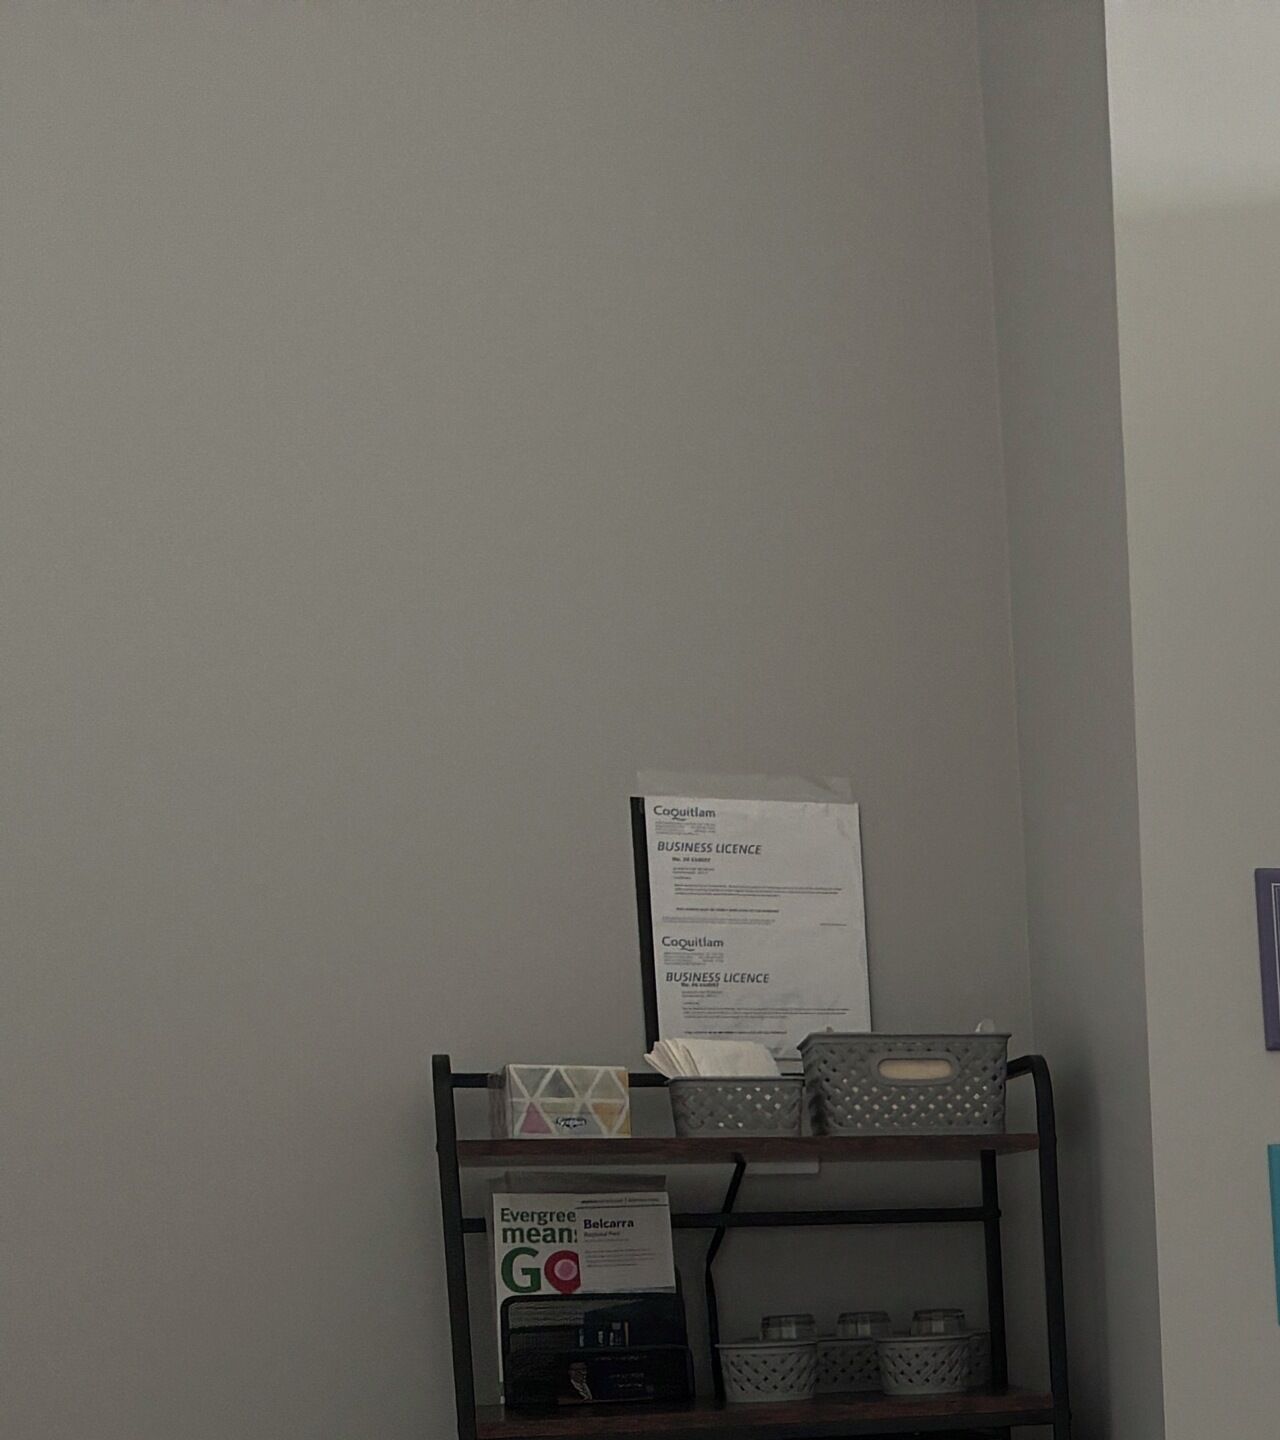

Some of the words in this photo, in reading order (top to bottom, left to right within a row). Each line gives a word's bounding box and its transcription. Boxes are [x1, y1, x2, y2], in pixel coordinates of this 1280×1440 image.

[657, 841, 713, 853] BUSINESS
[715, 843, 762, 855] LICENCE
[665, 972, 721, 982] BUSINESS
[723, 973, 769, 983] LICENCE
[501, 1207, 577, 1226] Evergree
[583, 1218, 634, 1230] Belcarra
